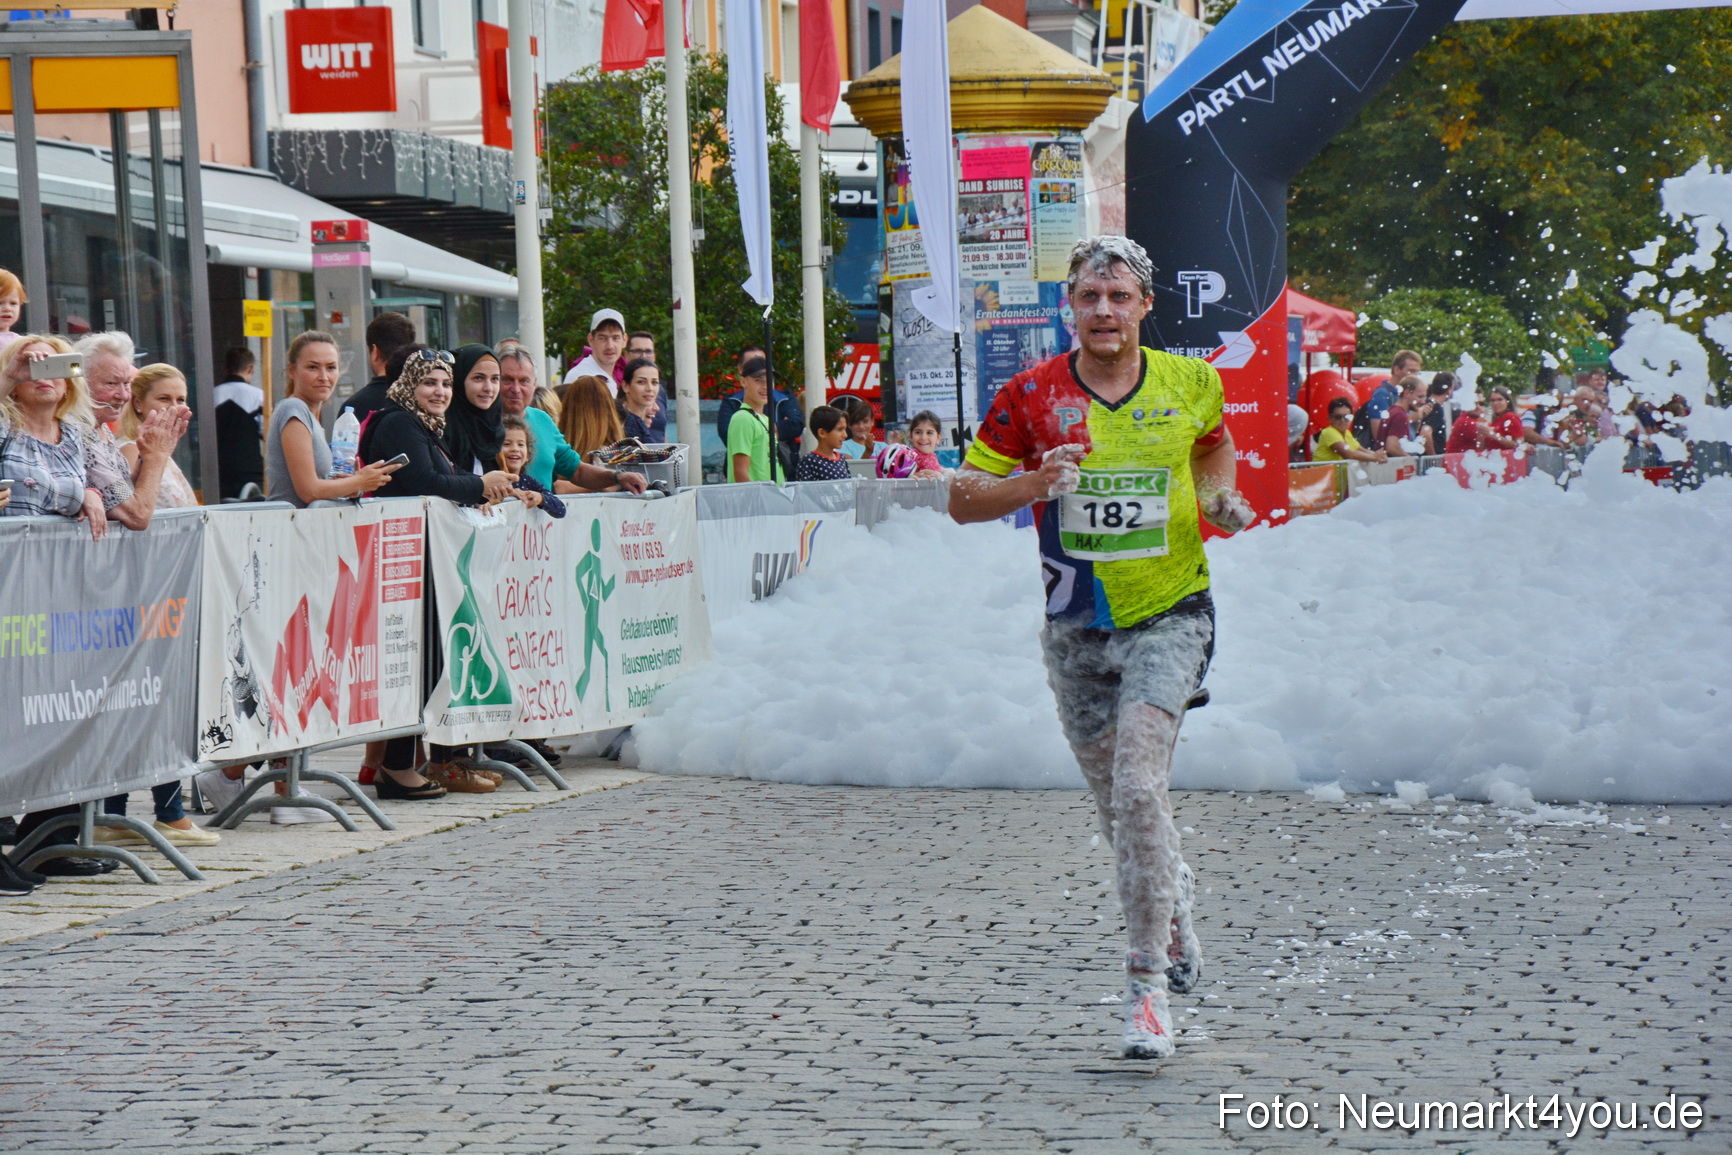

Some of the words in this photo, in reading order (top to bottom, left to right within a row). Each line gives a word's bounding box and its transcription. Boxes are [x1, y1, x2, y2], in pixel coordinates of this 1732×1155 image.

[301, 42, 373, 70] WITT
[1177, 69, 1266, 136] PARTL
[1262, 0, 1388, 78] NEUMAR
[319, 70, 359, 79] weiden
[959, 181, 983, 193] BAND
[986, 178, 1024, 191] SUNRISE
[990, 230, 1000, 240] 20
[1002, 228, 1026, 239] JAHRE
[898, 244, 909, 254] 21.
[910, 242, 923, 252] 09.
[962, 244, 999, 253] Gottesdienst
[1005, 242, 1026, 251] Konzert
[321, 253, 350, 262] HotSpot
[962, 253, 990, 263] 21.09.19
[996, 251, 1014, 261] 18.30
[1015, 251, 1026, 260] Uhr
[971, 262, 999, 271] Hofkirche
[1000, 261, 1027, 270] Neumarkt
[976, 309, 1040, 320] Erntedankfest
[1040, 307, 1059, 317] 2019
[992, 332, 1009, 340] Freitag
[1165, 347, 1185, 357] THE
[1186, 347, 1214, 357] NEXT
[920, 371, 928, 379] 19.
[930, 370, 943, 379] Okt.
[945, 370, 954, 378] 20
[1082, 502, 1144, 529] 182
[51, 606, 135, 654] INDUSTRY
[345, 636, 377, 685] Braun
